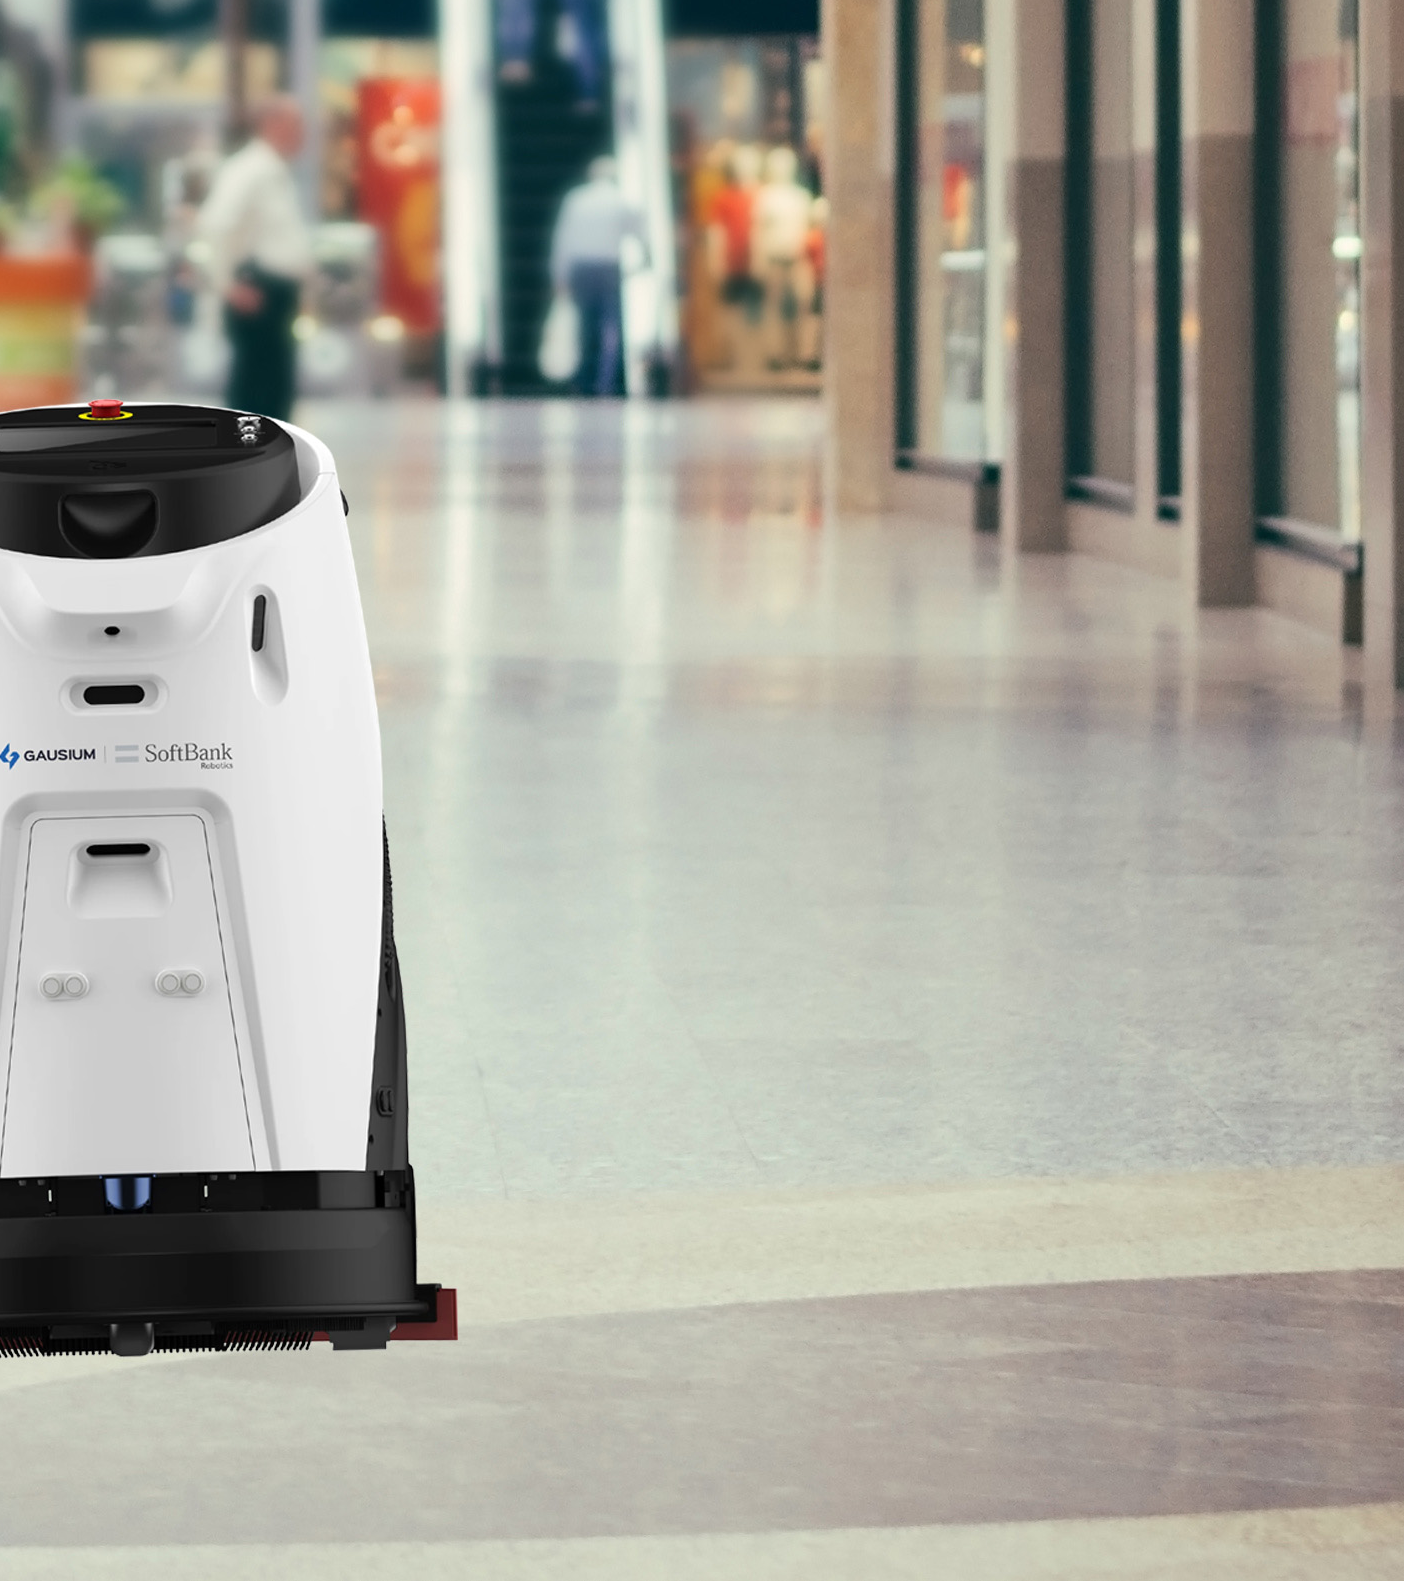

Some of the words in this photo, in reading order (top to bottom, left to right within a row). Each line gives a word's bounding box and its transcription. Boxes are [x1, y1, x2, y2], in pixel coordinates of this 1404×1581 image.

[23, 748, 96, 762] GAUSIUM
[144, 742, 233, 763] SoftBank
[200, 762, 234, 770] Robotics
